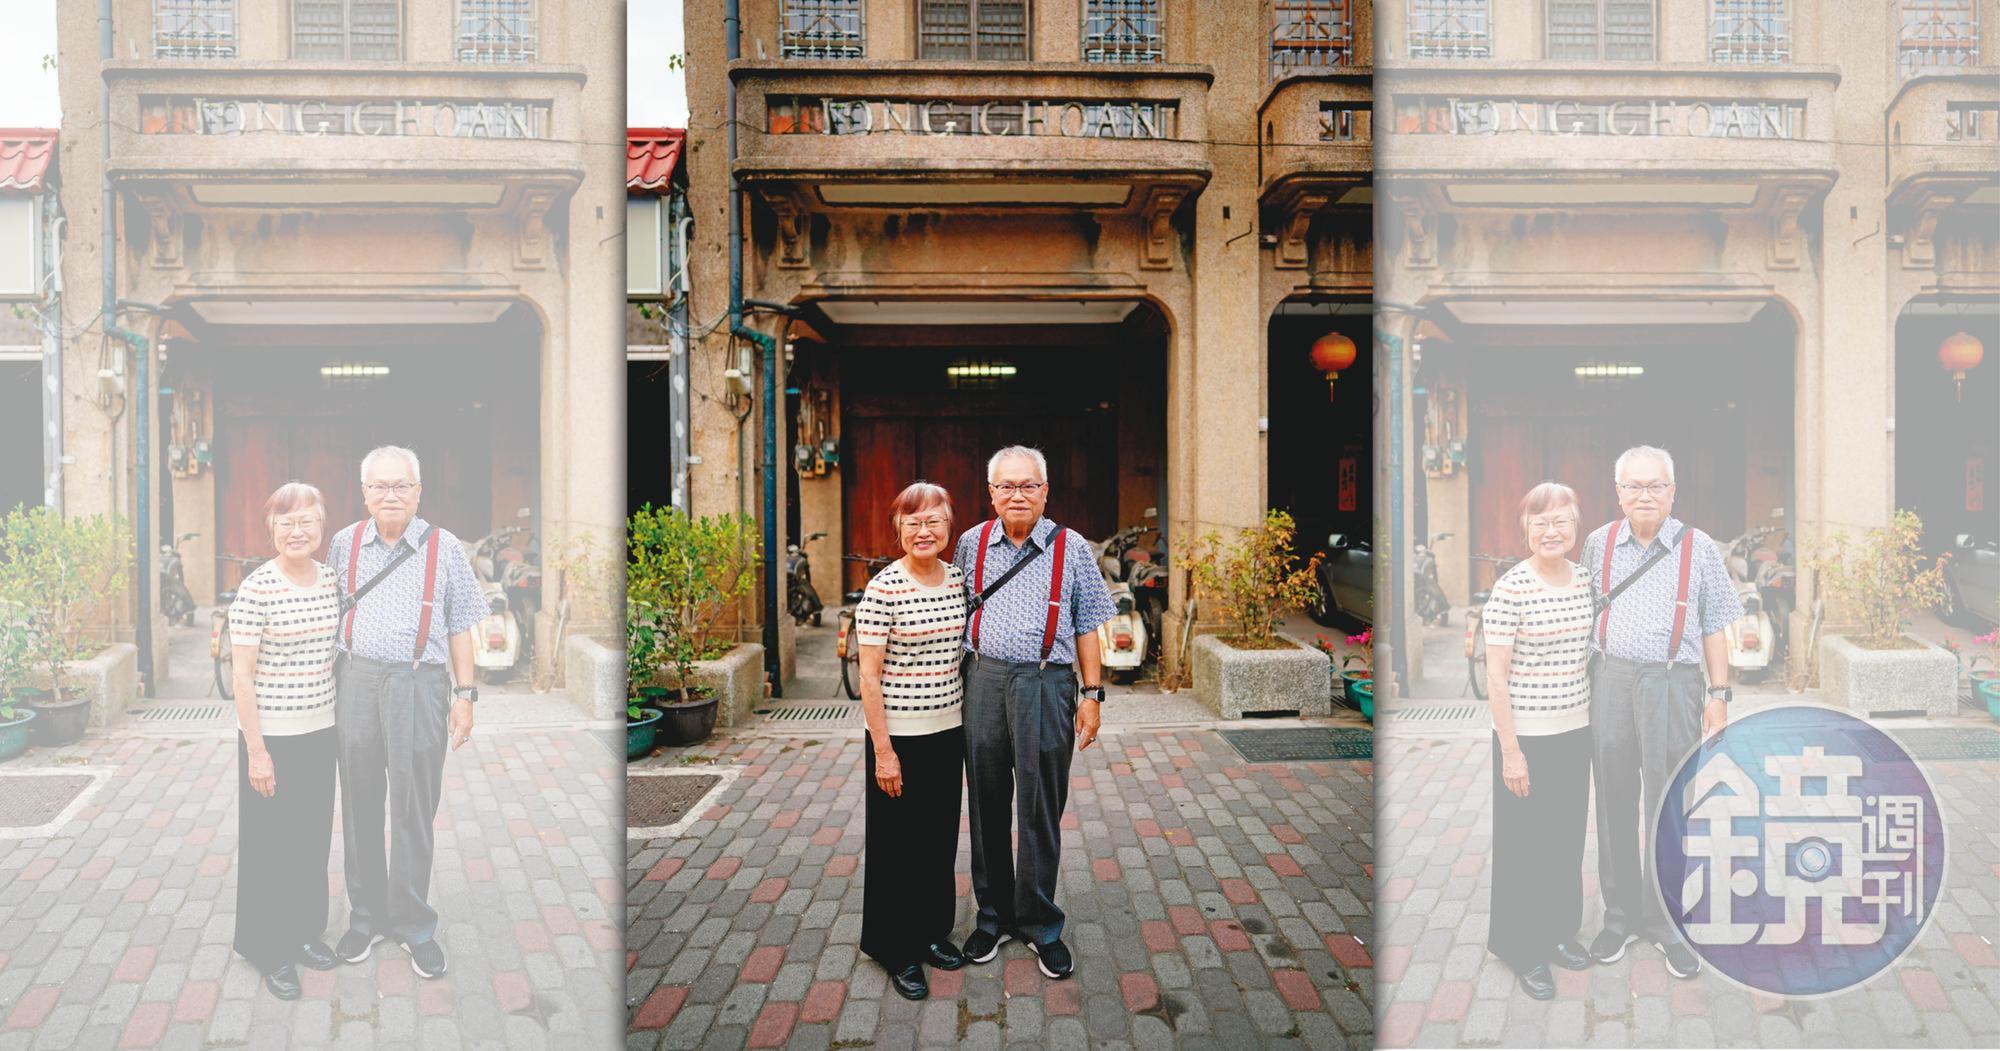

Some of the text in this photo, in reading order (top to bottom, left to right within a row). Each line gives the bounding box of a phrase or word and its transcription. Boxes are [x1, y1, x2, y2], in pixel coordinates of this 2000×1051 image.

[353, 100, 534, 138] CHOAN
[980, 100, 1161, 138] CHOAN
[1607, 100, 1788, 138] CHOAN
